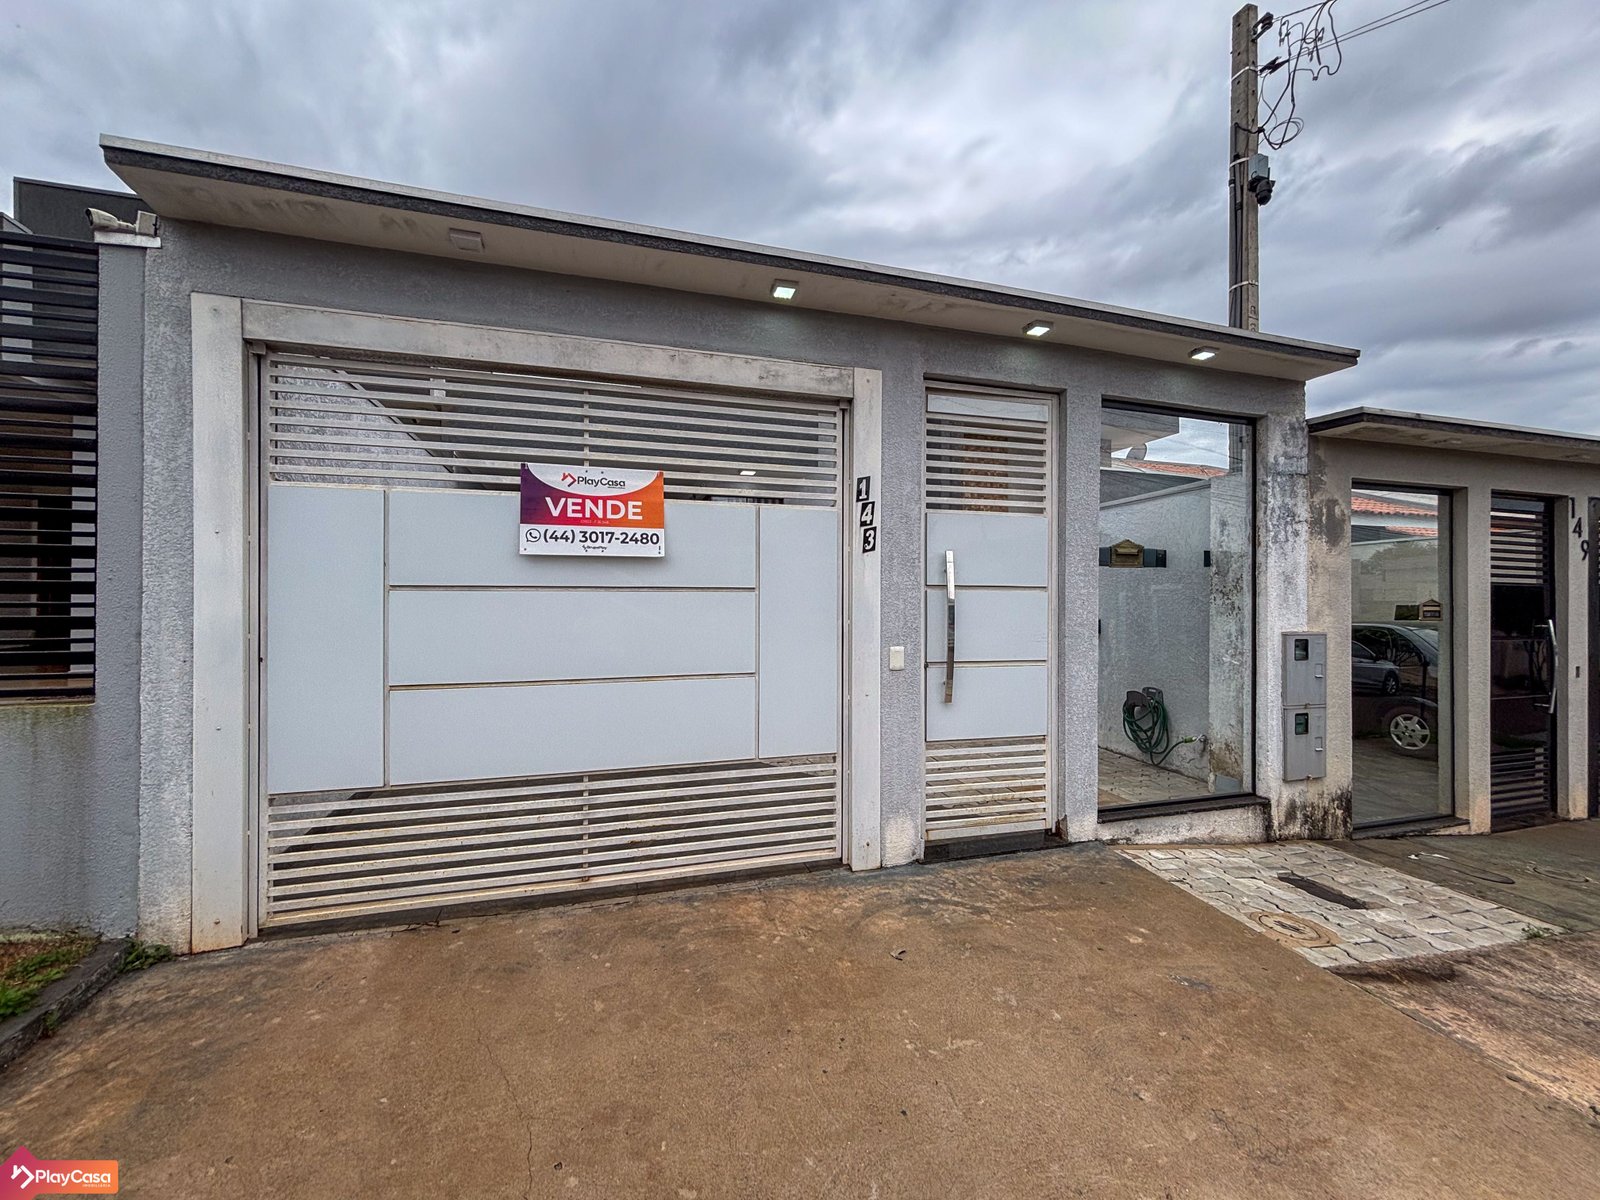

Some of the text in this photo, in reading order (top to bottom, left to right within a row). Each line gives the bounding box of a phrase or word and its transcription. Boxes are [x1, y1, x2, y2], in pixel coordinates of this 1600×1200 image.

[577, 476, 626, 488] PlayCasa
[545, 496, 643, 520] VENDE
[859, 479, 875, 550] 143
[543, 528, 660, 545] (44) 3017-2480
[1569, 497, 1590, 561] 149
